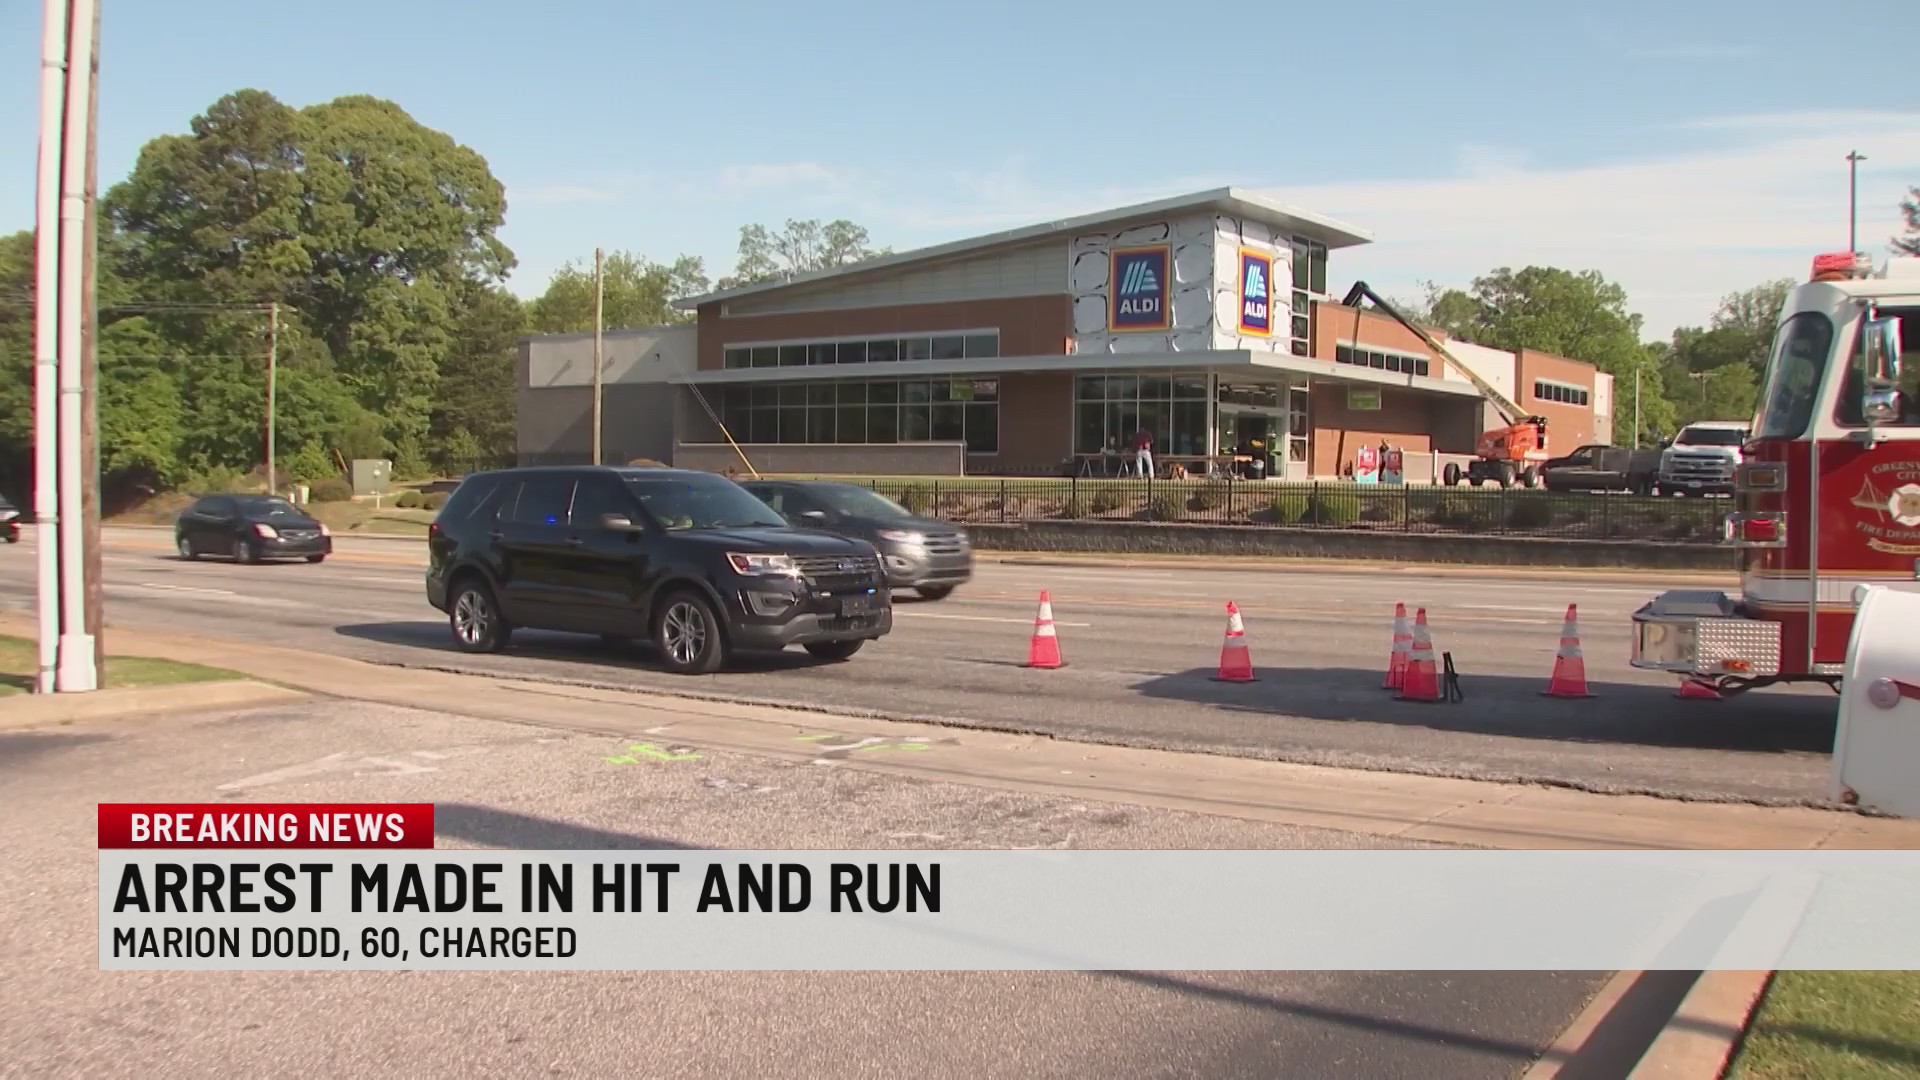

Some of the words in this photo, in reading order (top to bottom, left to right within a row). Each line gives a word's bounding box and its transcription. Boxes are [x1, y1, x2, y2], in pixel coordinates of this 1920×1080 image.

[1120, 297, 1160, 314] ALDI
[1244, 301, 1267, 319] ALDI
[1856, 521, 1883, 537] FIRE
